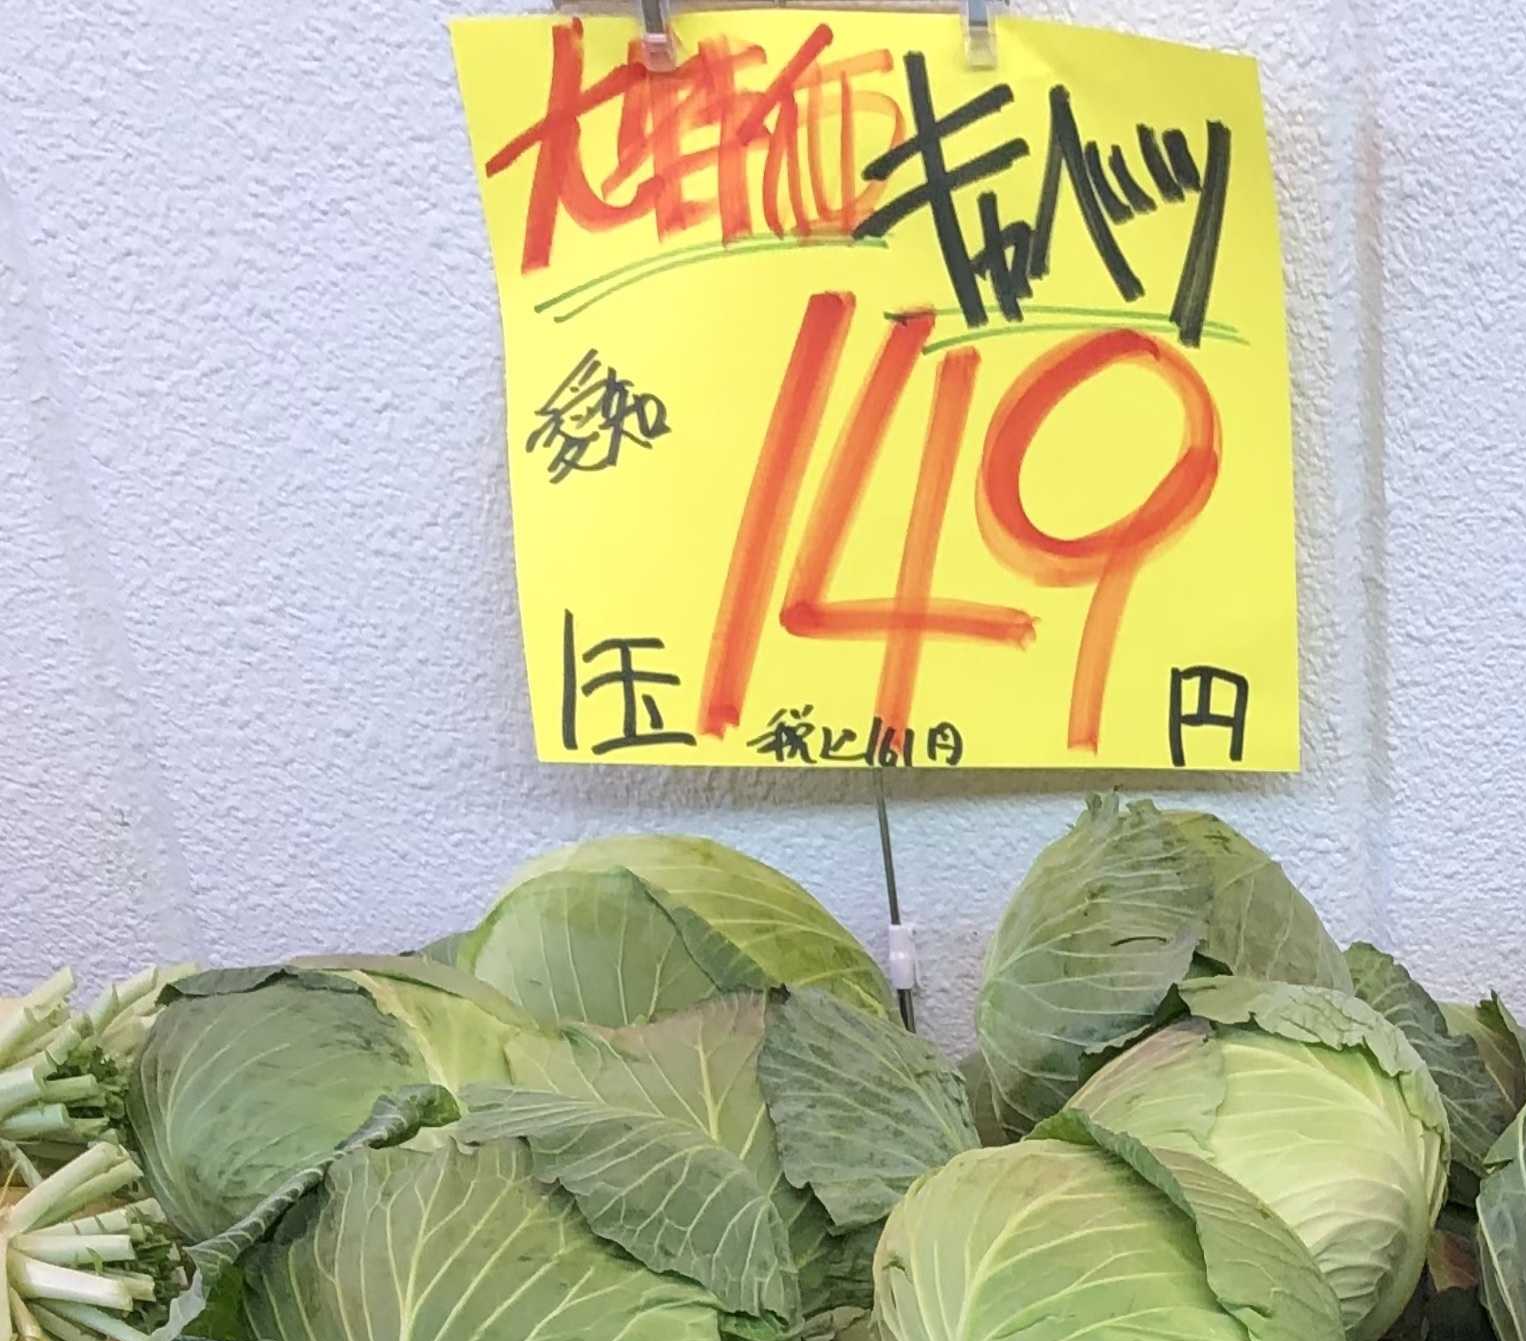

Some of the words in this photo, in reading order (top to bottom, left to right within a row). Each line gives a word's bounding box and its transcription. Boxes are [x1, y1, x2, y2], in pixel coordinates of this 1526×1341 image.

[855, 50, 1231, 347] キャベツ
[526, 349, 669, 483] 愛知
[698, 290, 1223, 756] 149
[1169, 665, 1249, 766] 円
